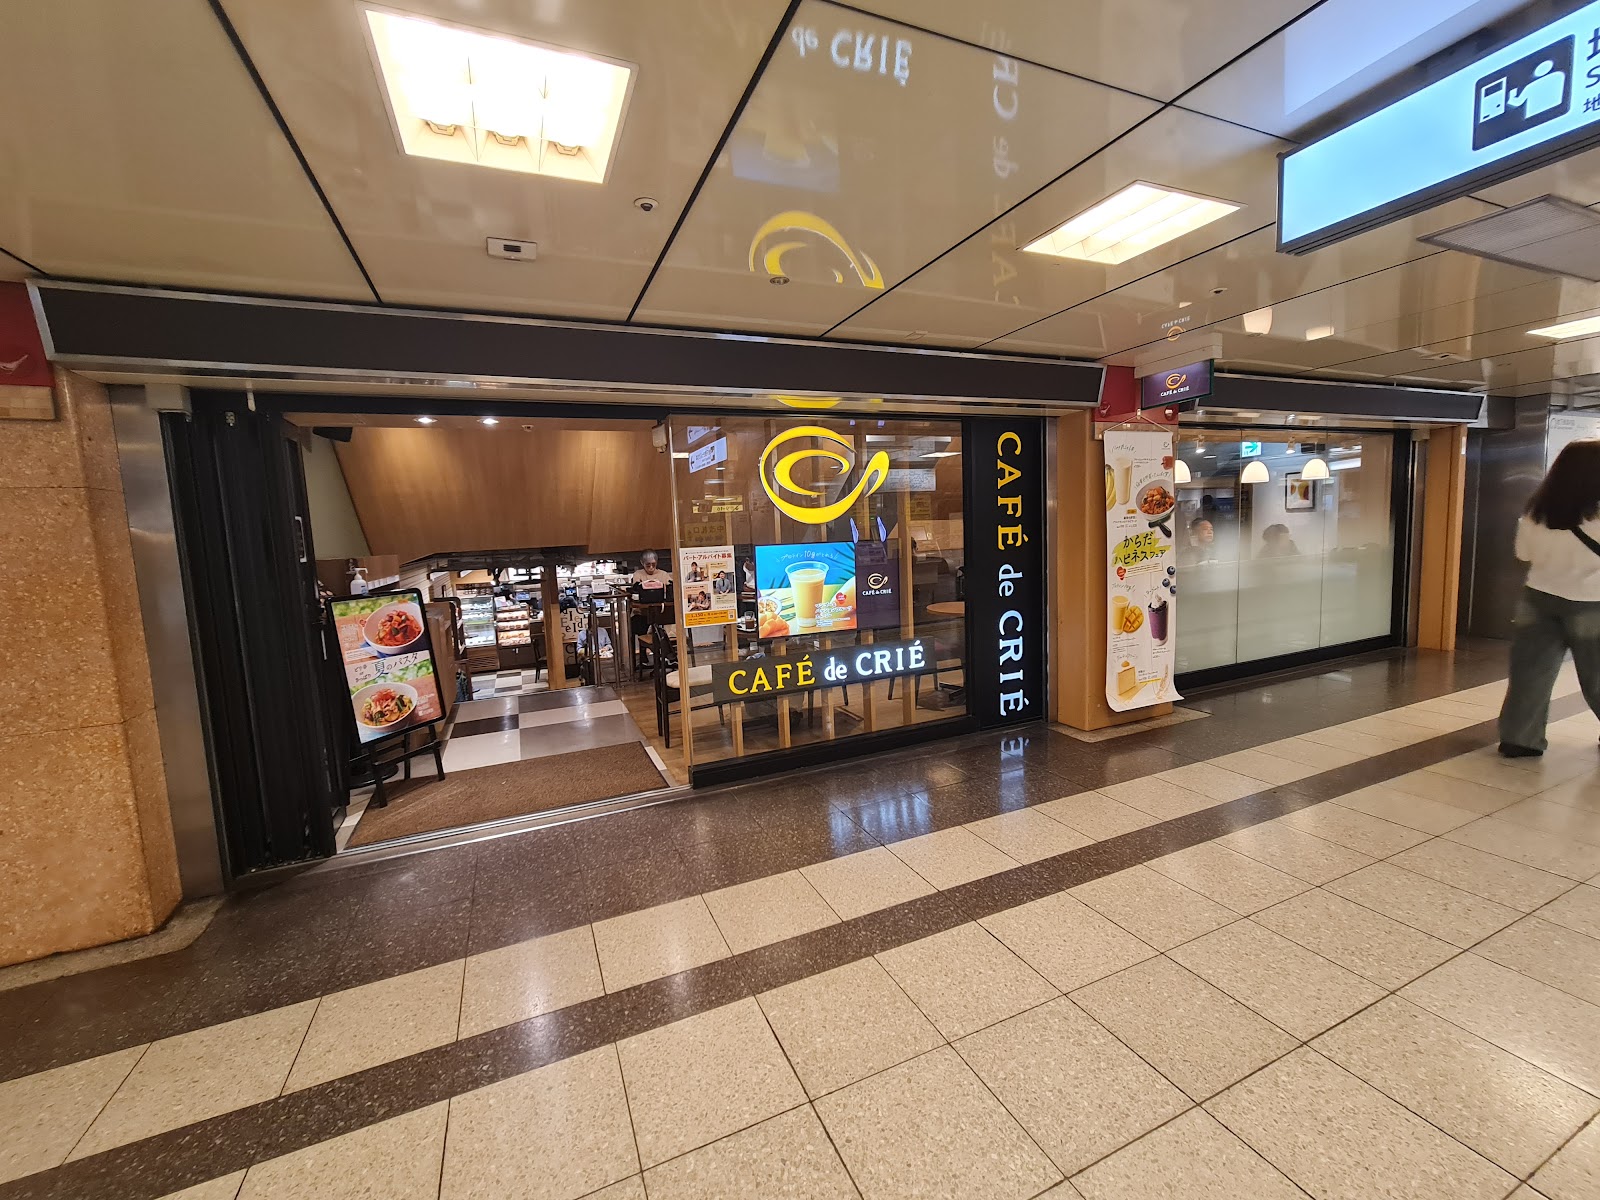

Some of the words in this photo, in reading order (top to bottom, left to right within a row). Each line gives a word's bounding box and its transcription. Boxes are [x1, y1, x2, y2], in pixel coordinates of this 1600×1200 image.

[997, 431, 1028, 550] CAFÉ
[1114, 549, 1167, 565] ハピネスフェア
[1123, 532, 1153, 549] からだ
[998, 563, 1023, 597] de
[373, 652, 418, 678] 夏のパスタ
[729, 654, 815, 695] CAFÉ
[824, 656, 848, 681] de
[855, 640, 926, 676] CRIÉ
[999, 609, 1029, 716] CRIÉ
